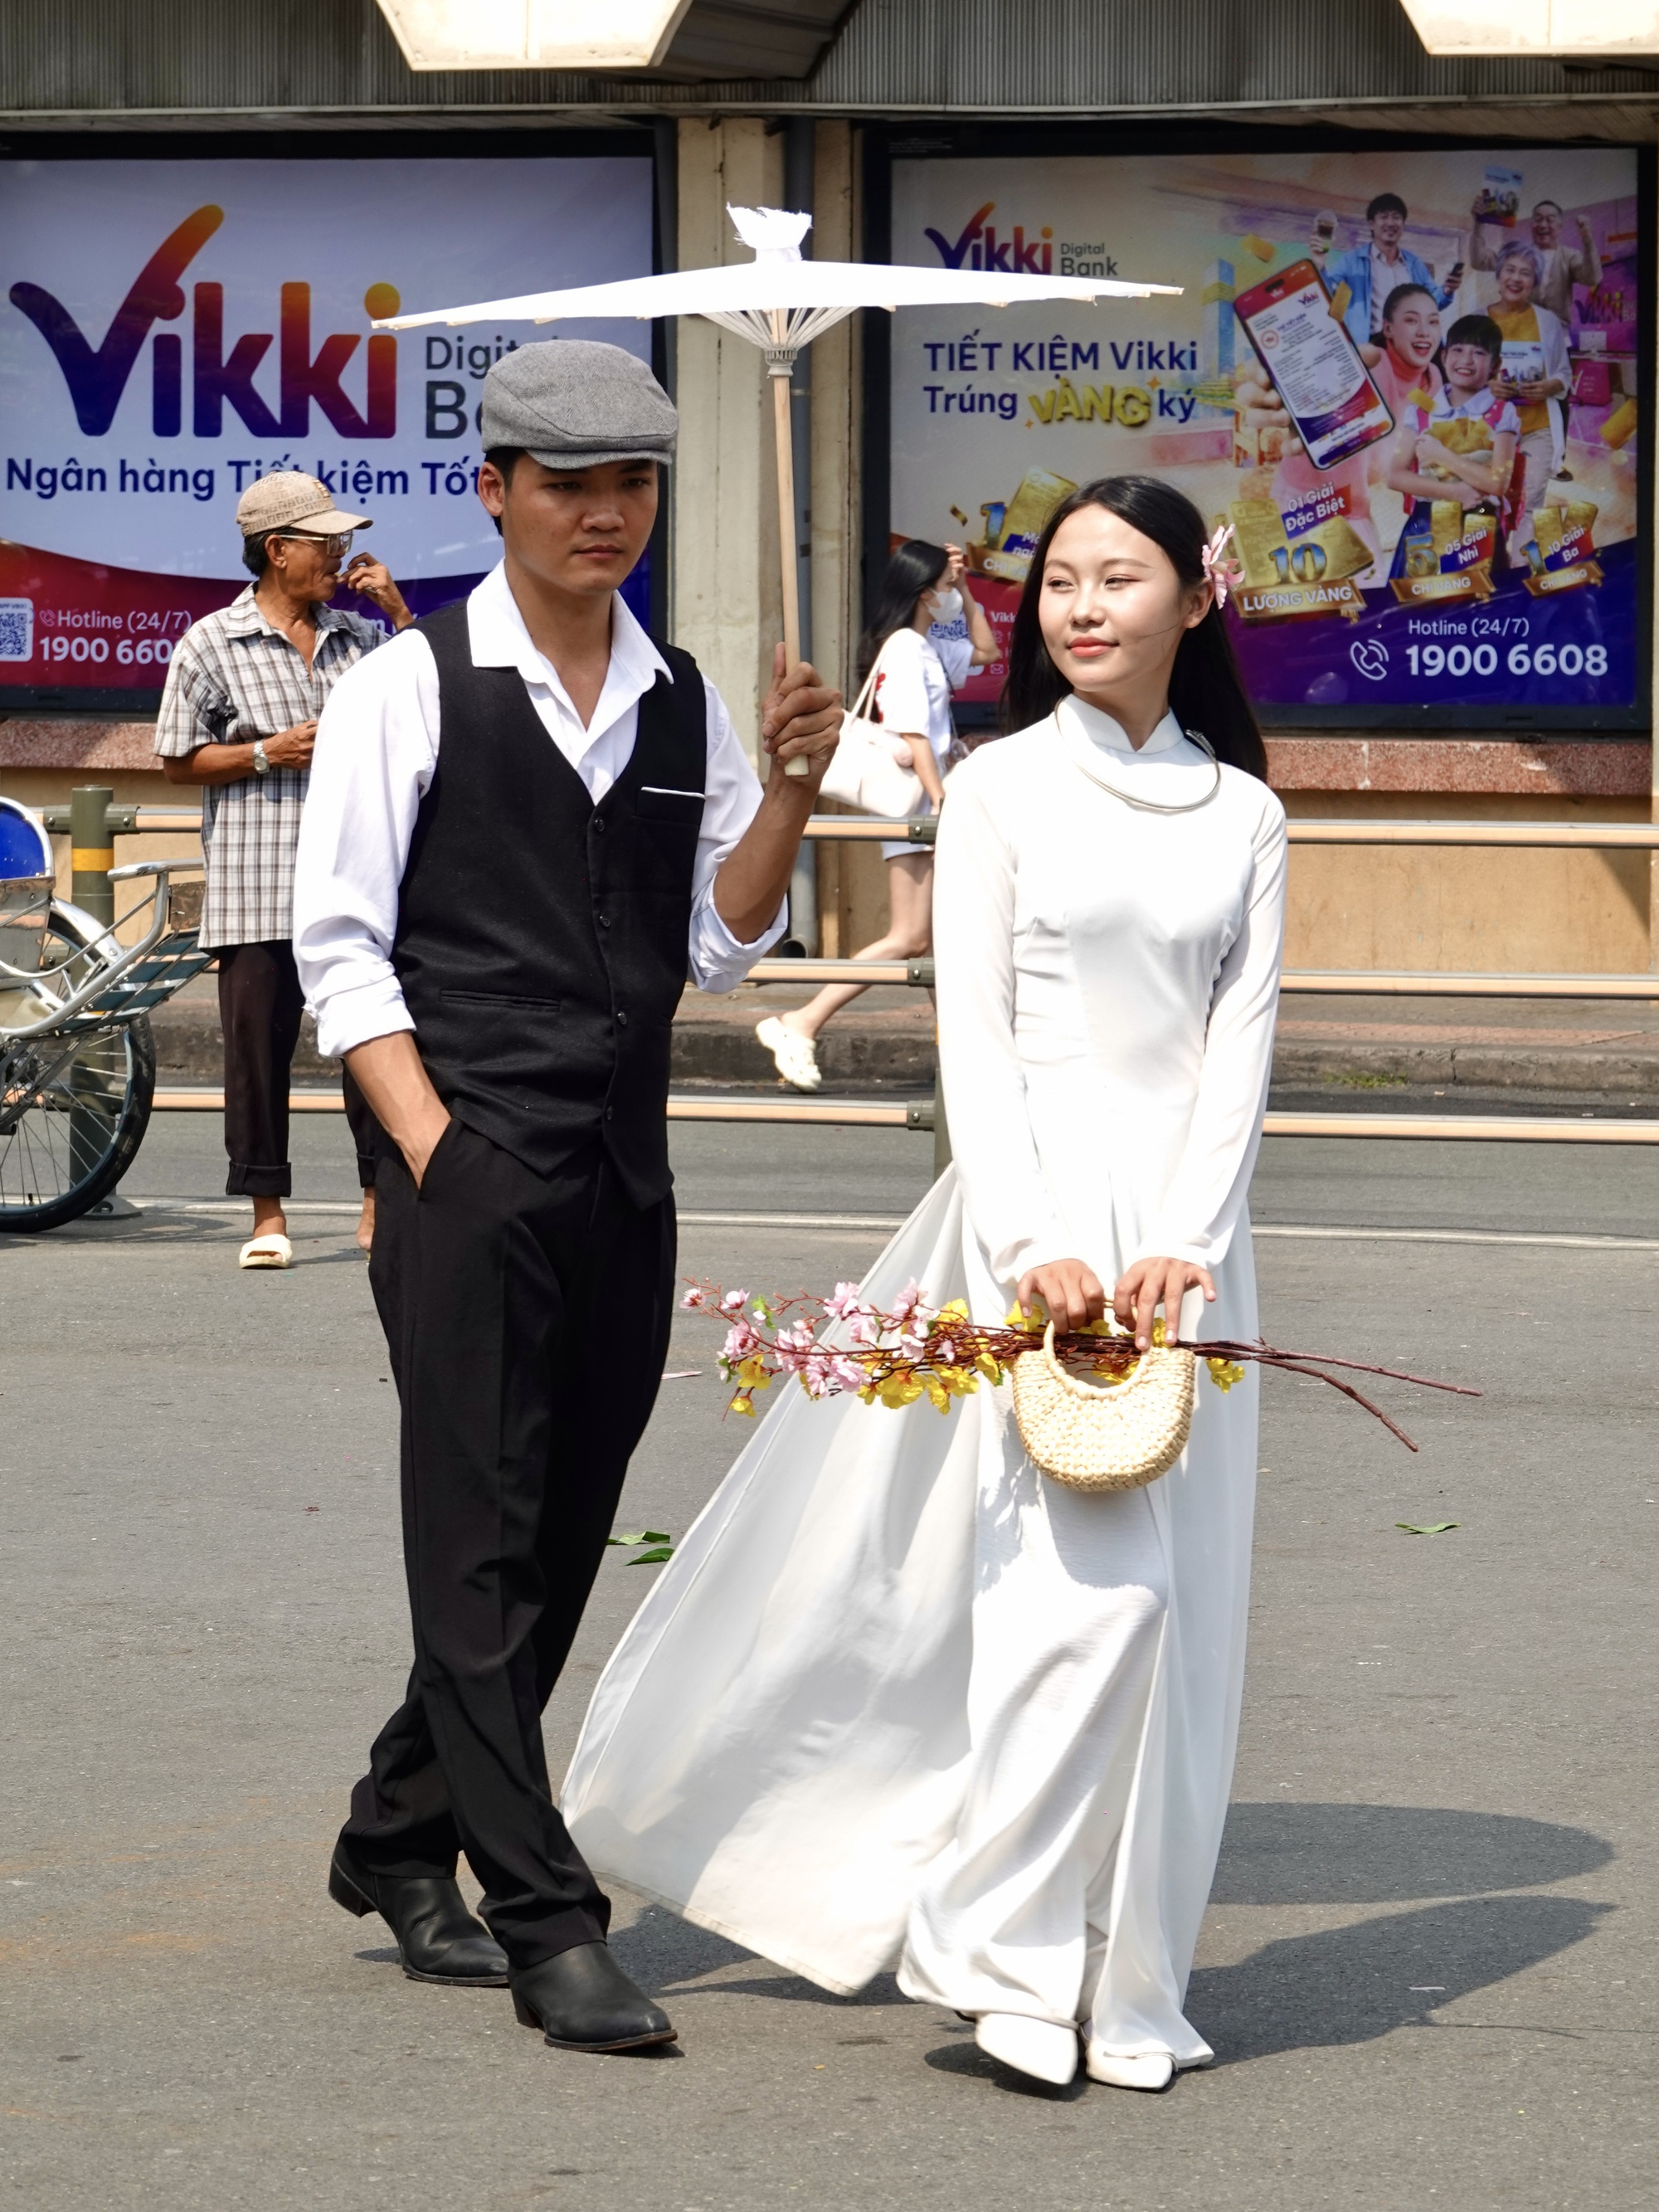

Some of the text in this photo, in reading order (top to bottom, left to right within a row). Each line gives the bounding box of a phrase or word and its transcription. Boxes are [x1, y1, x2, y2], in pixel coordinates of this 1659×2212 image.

[924, 201, 1105, 275] Vikki Digital
[1061, 256, 1119, 276] Bank
[9, 205, 401, 439] Vikki
[426, 335, 558, 379] Digi
[923, 329, 1198, 379] TIẾT KIỆM Vikki
[923, 378, 1197, 426] Trúng VÀNG ký
[7, 457, 107, 499] Ngân
[119, 458, 216, 502] hàng
[317, 459, 409, 504] kiệm
[421, 455, 480, 496] Tốt
[1288, 481, 1335, 512] 01 Giải
[980, 501, 1007, 551] 1
[1285, 495, 1345, 532] Đặc Biệt
[1444, 525, 1487, 555] 05 Giải
[1548, 540, 1561, 556] 10
[1562, 547, 1579, 563] Ba
[1268, 543, 1327, 584] 10
[1243, 584, 1353, 612] LƯỢNG VÀNG
[1436, 574, 1472, 592] VÀNG
[57, 610, 192, 634] Hotline (24/7)
[990, 611, 1017, 623] Vikk
[1408, 617, 1530, 637] Hotline (24/7)
[40, 636, 178, 665] 1900 660
[1406, 644, 1608, 676] 1900 6608
